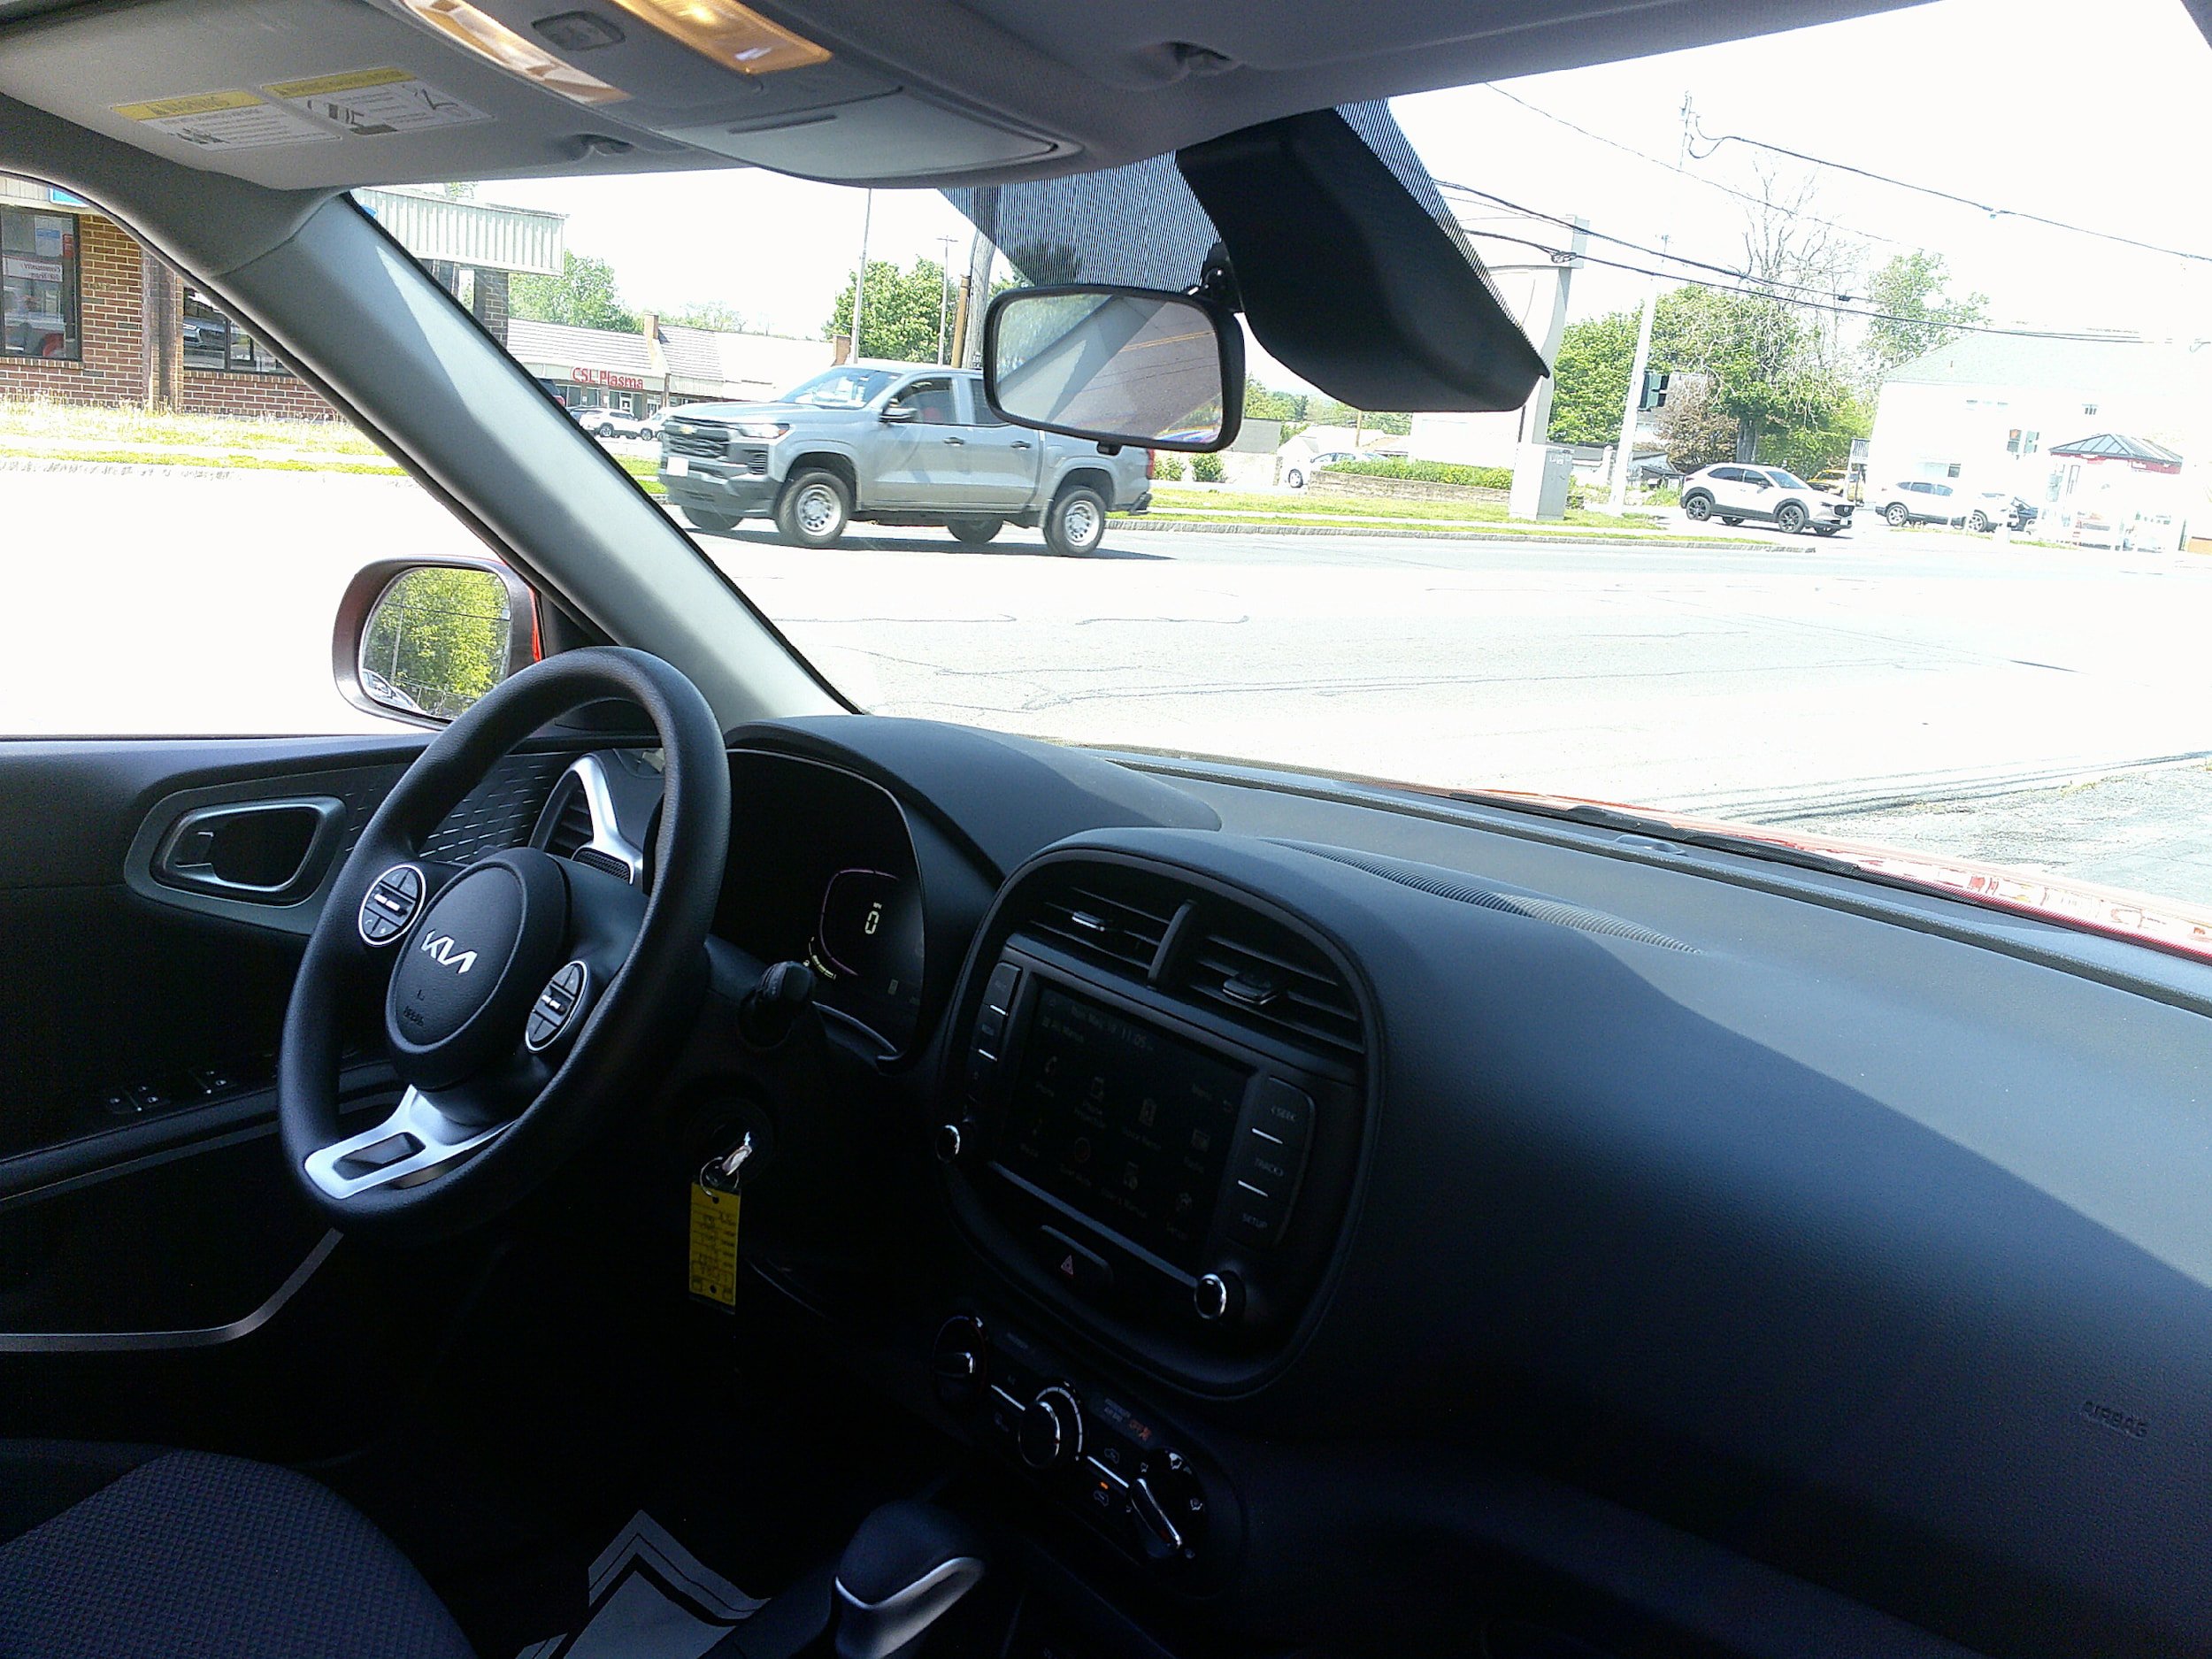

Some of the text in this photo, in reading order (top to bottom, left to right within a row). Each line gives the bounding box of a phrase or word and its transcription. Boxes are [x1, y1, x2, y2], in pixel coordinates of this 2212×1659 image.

[572, 367, 643, 389] CSL Plasma
[420, 929, 478, 974] KIA
